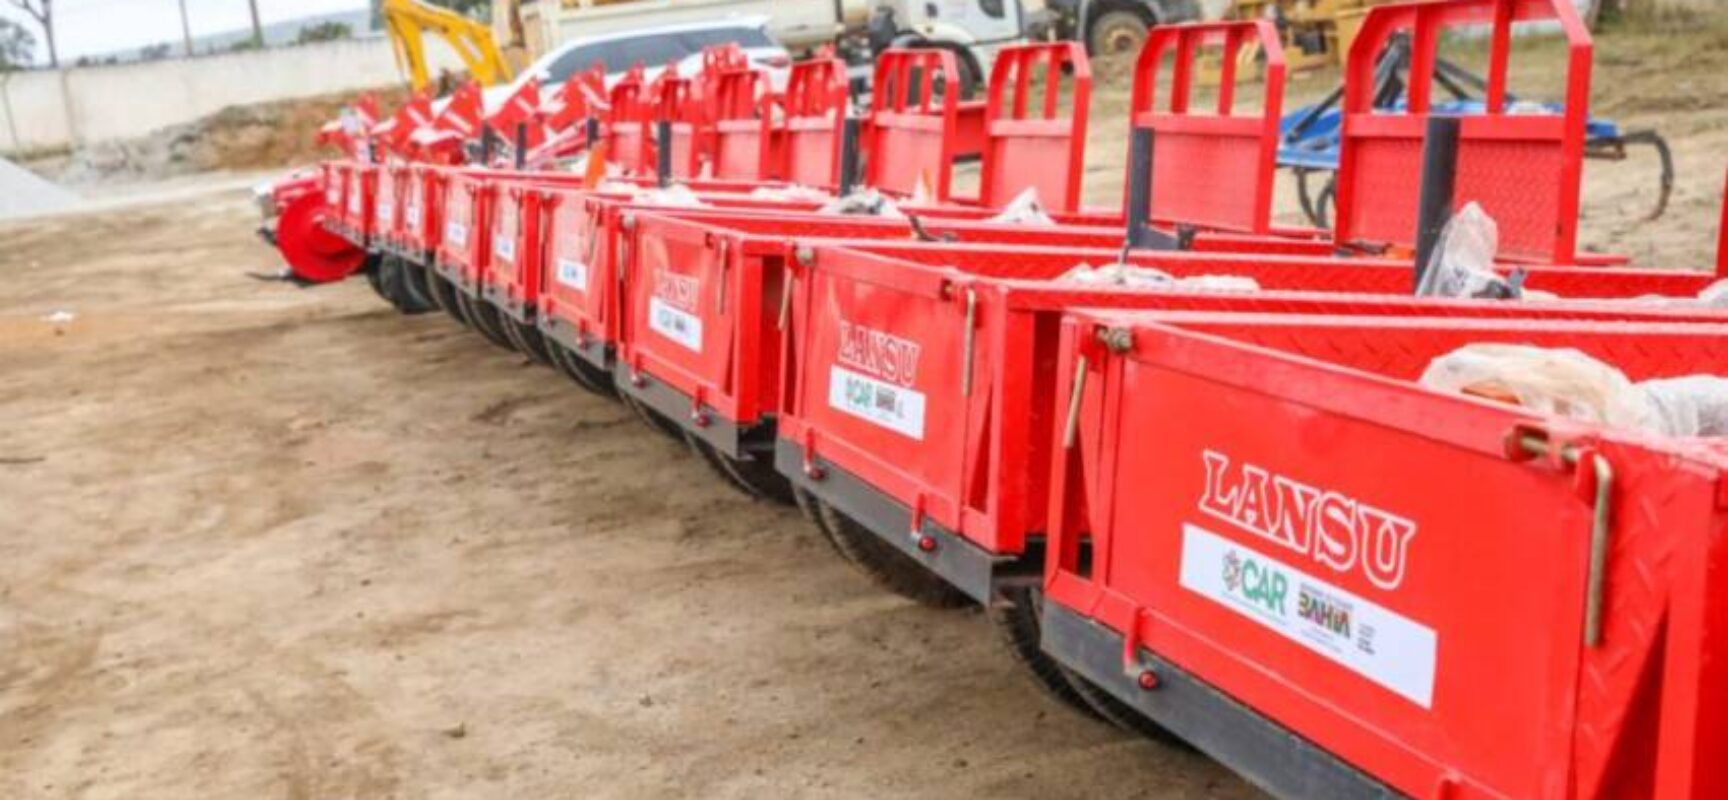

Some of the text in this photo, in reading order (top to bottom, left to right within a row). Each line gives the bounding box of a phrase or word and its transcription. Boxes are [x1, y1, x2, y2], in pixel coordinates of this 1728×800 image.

[838, 319, 921, 388] LANSU
[1198, 449, 1416, 590] LANSU
[1241, 559, 1288, 616] CAR
